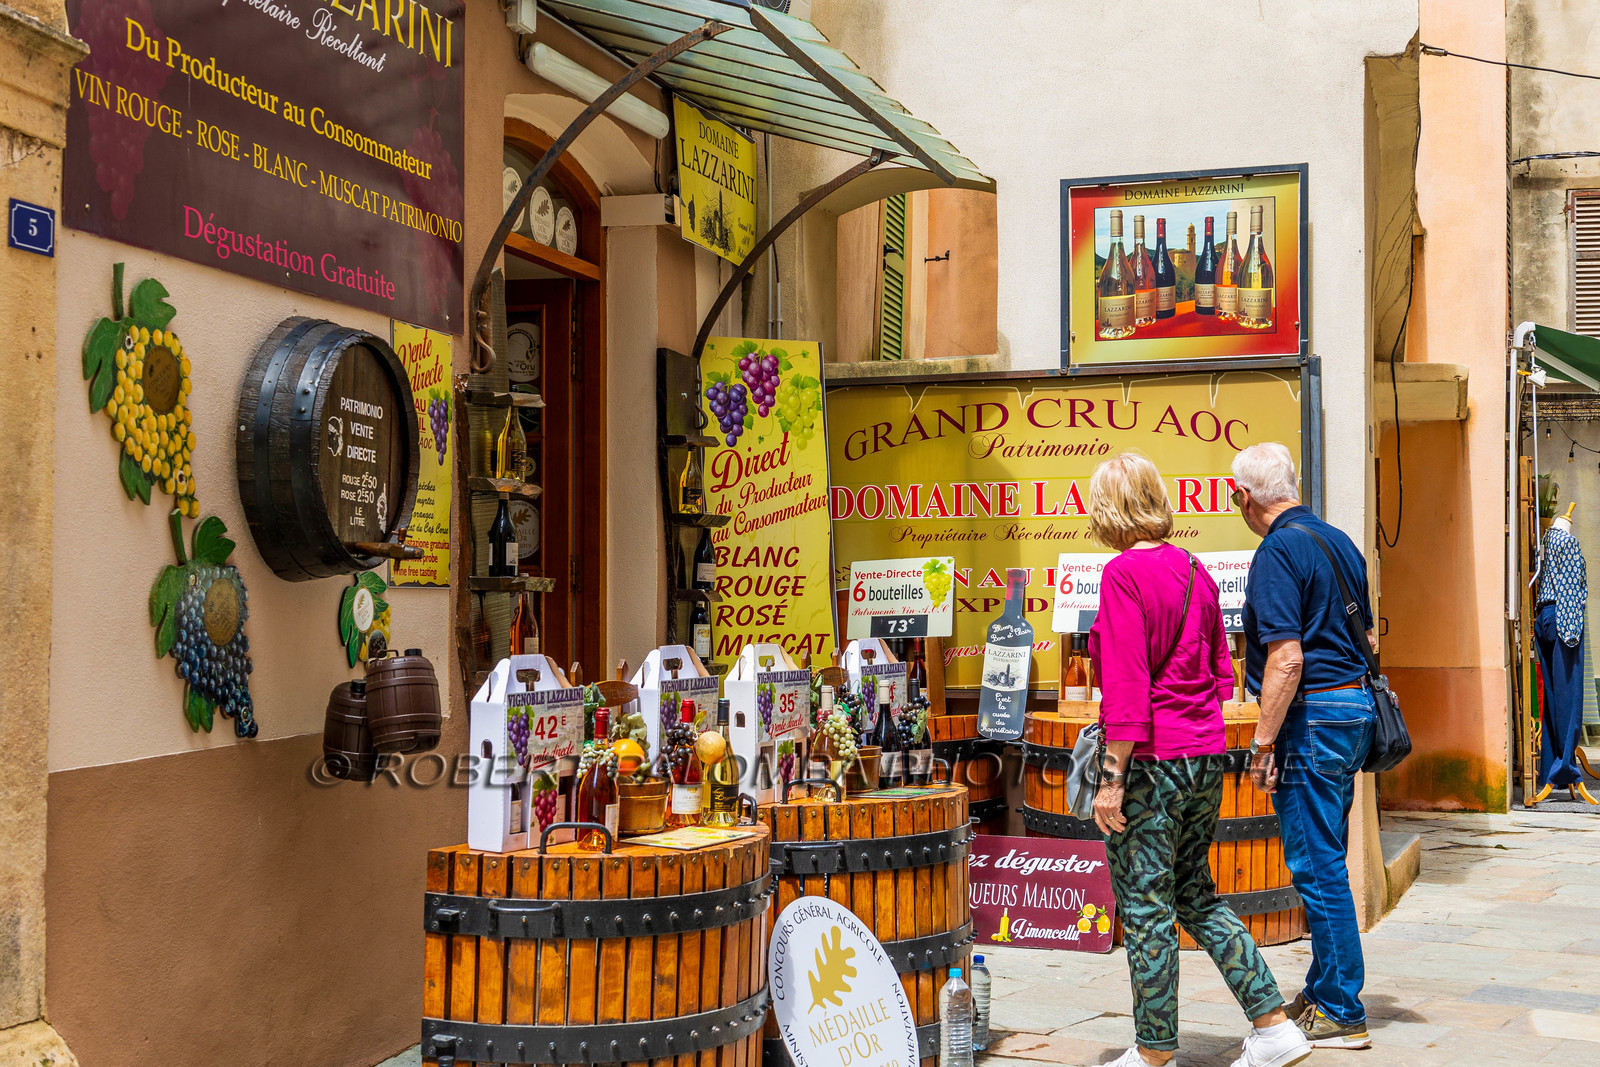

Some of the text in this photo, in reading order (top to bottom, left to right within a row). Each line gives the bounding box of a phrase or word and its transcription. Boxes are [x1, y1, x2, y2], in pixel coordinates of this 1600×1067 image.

[306, 7, 386, 73] Récoltant
[125, 17, 432, 180] Du Producteur au Consommateur
[698, 121, 739, 159] DOMAINE
[75, 67, 111, 110] VIN
[116, 85, 182, 138] ROUGE
[197, 119, 240, 161] ROSE
[253, 142, 308, 187] BLANC
[319, 170, 379, 215] MUSCAT
[382, 194, 463, 243] PATRIMONIO
[680, 137, 755, 205] LAZZARINI
[1124, 183, 1245, 201] DOMAINE LAZZARINI
[28, 217, 38, 237] 5
[183, 205, 396, 300] Dégustation Gratuite
[397, 329, 433, 376] Vente
[410, 354, 443, 392] directe
[340, 397, 384, 420] PATRIMONIO
[350, 421, 374, 440] VENTE
[844, 398, 1249, 461] GRAND CRU AOC
[346, 444, 377, 463] DIRECTE
[968, 433, 1114, 460] Patrimonio
[709, 431, 790, 493] Direct
[341, 474, 361, 486] ROUGE
[340, 489, 356, 501] ROSE
[715, 471, 813, 516] du Producteur
[829, 481, 1022, 521] DOMAINE
[350, 516, 366, 527] LITRE
[354, 506, 363, 516] LE
[712, 492, 828, 545] au Consommateur
[430, 540, 450, 551] gratuita
[889, 525, 988, 549] Propriétaire
[993, 522, 1080, 542] Récoltant
[422, 553, 438, 565] probe
[715, 546, 800, 567] BLANC
[1062, 563, 1106, 573] Vente-D
[408, 566, 419, 577] free
[419, 567, 437, 580] tasting
[854, 569, 923, 580] Vente-Directe
[1060, 573, 1073, 595] 6
[1076, 579, 1101, 595] bou
[715, 575, 806, 598] ROUGE
[853, 580, 924, 602] 6 bouteilles
[716, 600, 788, 628] ROSÉ
[988, 648, 1027, 658] LAZZARINI
[661, 677, 718, 692] VIGNOBLE LAZZARINI
[757, 669, 810, 683] VIGNOBLE LAZZARINI
[507, 691, 545, 707] VIGNOBLE
[547, 687, 584, 703] LAZZARINI
[551, 740, 575, 758] directe
[994, 849, 1104, 876] déguster
[1022, 882, 1086, 911] MAISON
[774, 902, 884, 1001] CONCOURS GÉNÉRAL AGRICOLE
[808, 998, 891, 1049] MÉDAILLE
[838, 1031, 884, 1067] D'OR
